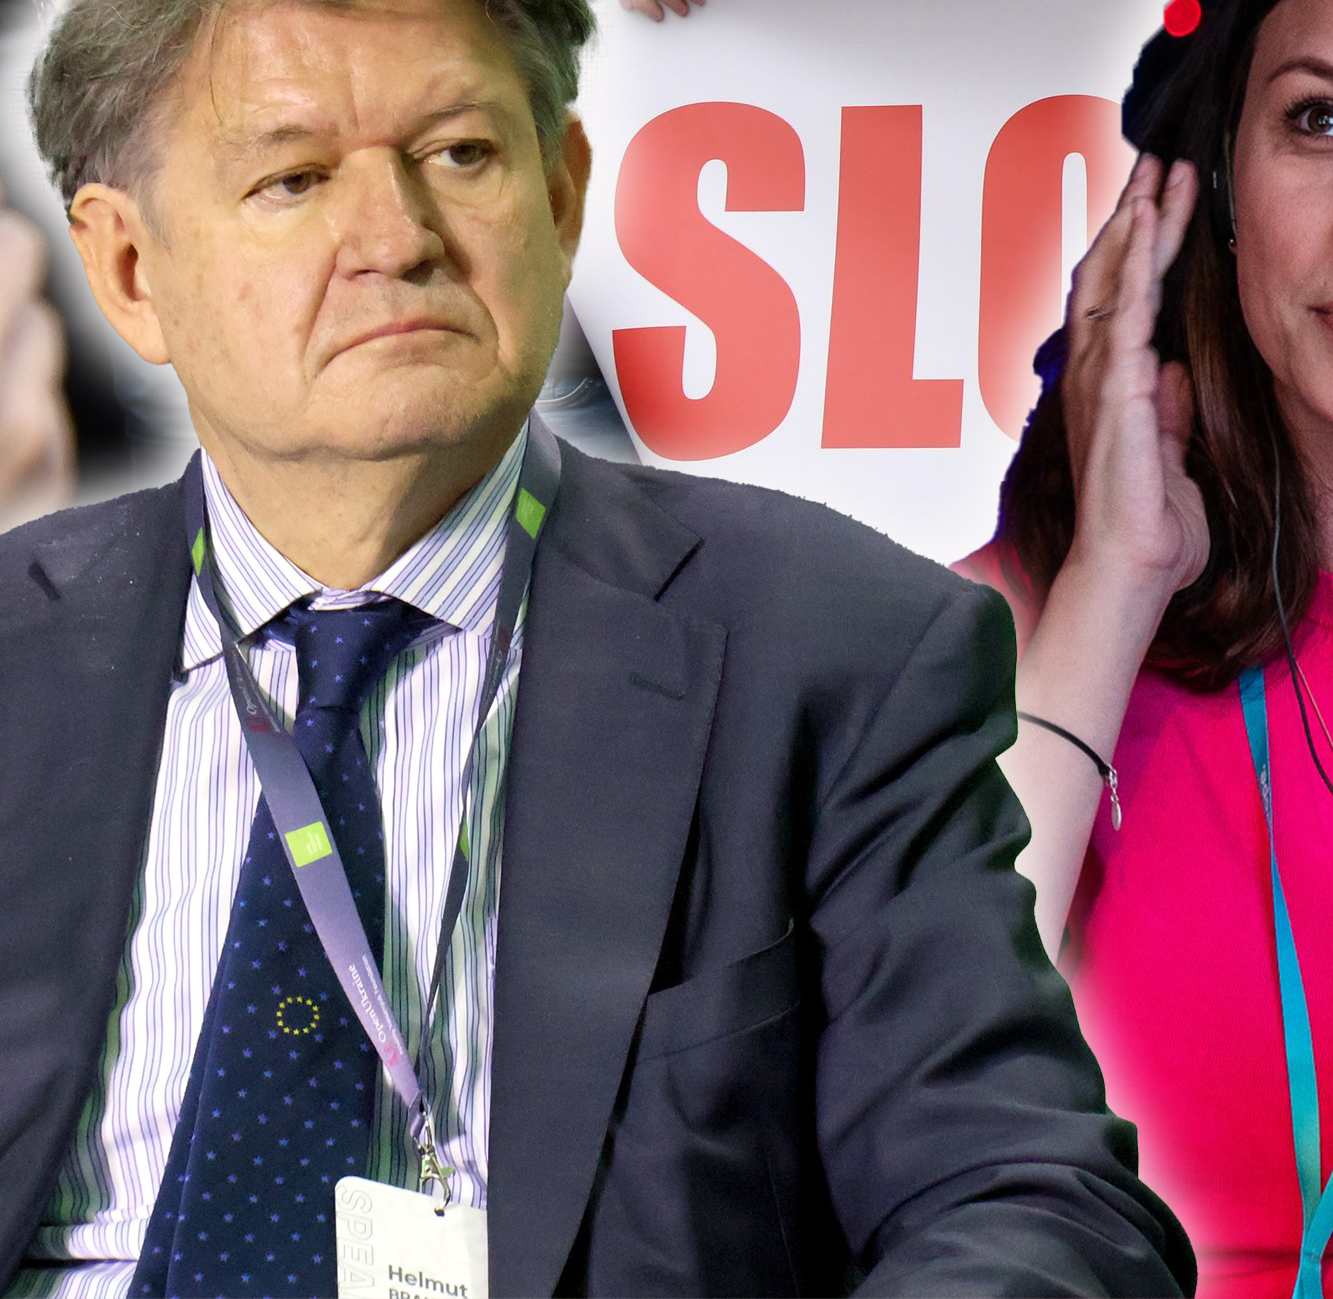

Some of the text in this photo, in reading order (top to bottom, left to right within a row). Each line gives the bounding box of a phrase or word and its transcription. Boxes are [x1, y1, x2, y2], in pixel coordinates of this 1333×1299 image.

[348, 963, 387, 1044] OpenUkraine
[335, 1184, 376, 1298] SPEA
[388, 1264, 469, 1299] Helmut
